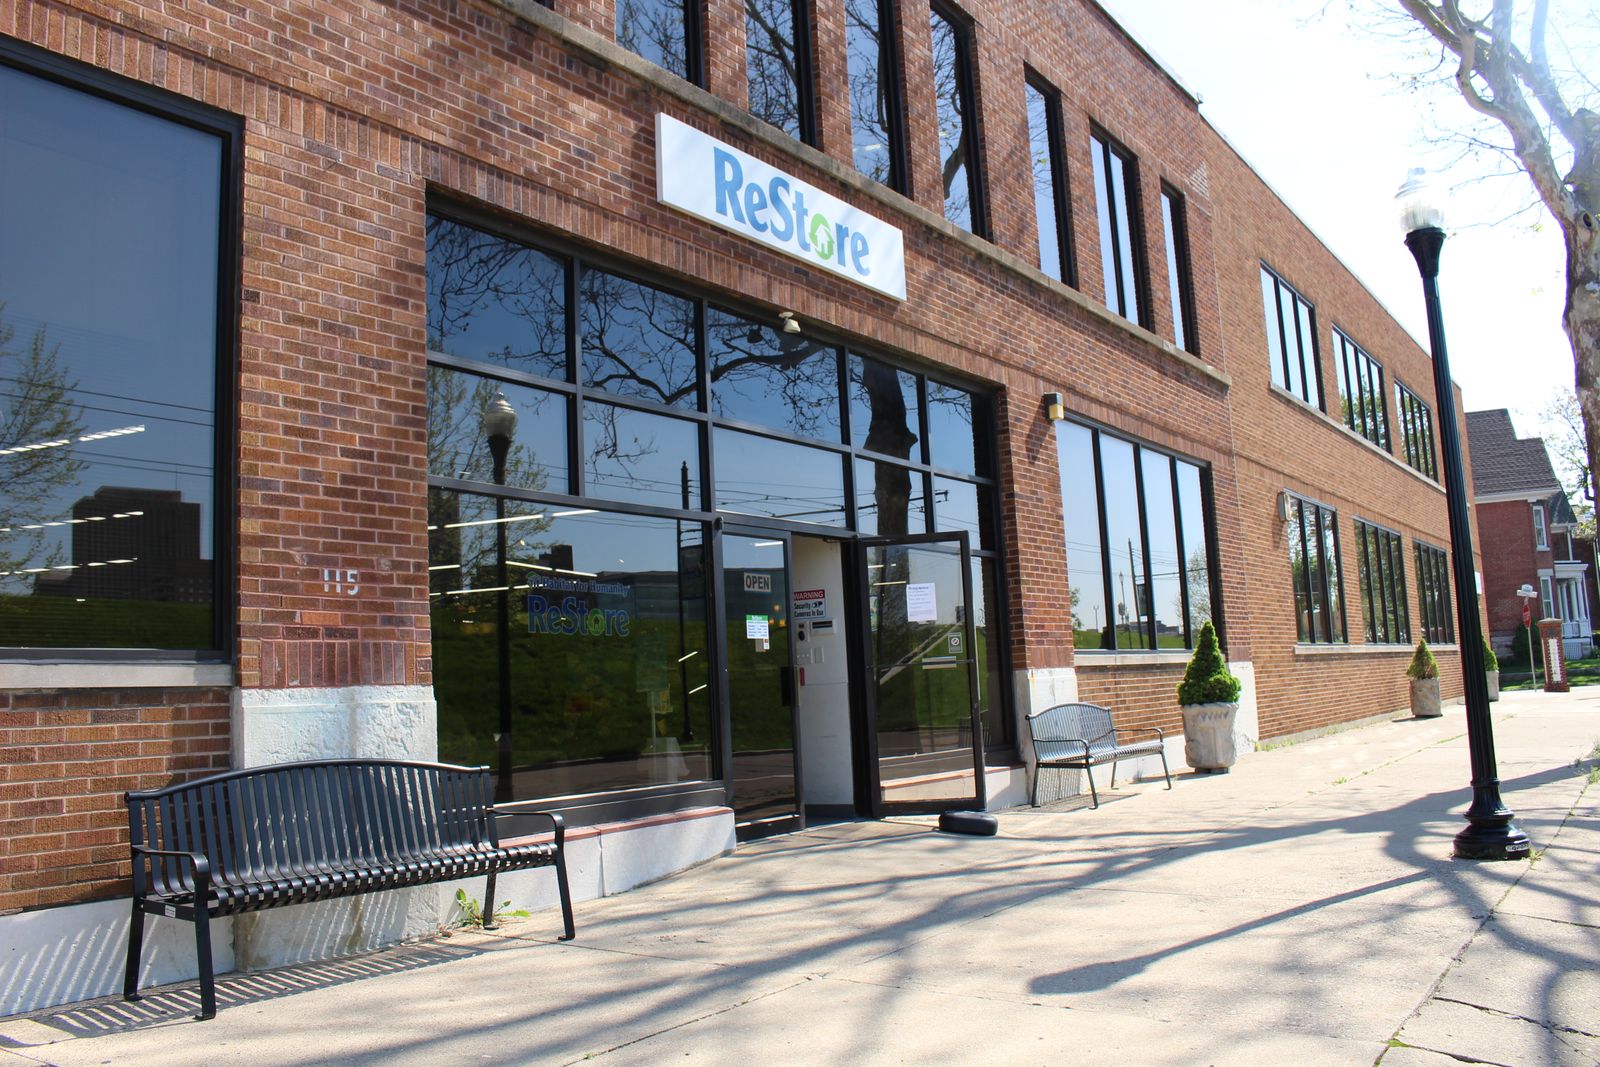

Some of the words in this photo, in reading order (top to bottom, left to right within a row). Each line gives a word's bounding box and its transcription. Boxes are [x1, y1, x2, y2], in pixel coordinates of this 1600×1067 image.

[713, 146, 871, 277] ReStore
[324, 569, 359, 596] 115
[542, 575, 575, 591] Habitat
[576, 579, 588, 592] for
[745, 574, 770, 590] OPEN
[794, 590, 824, 600] WARNING
[528, 595, 630, 637] ReStore
